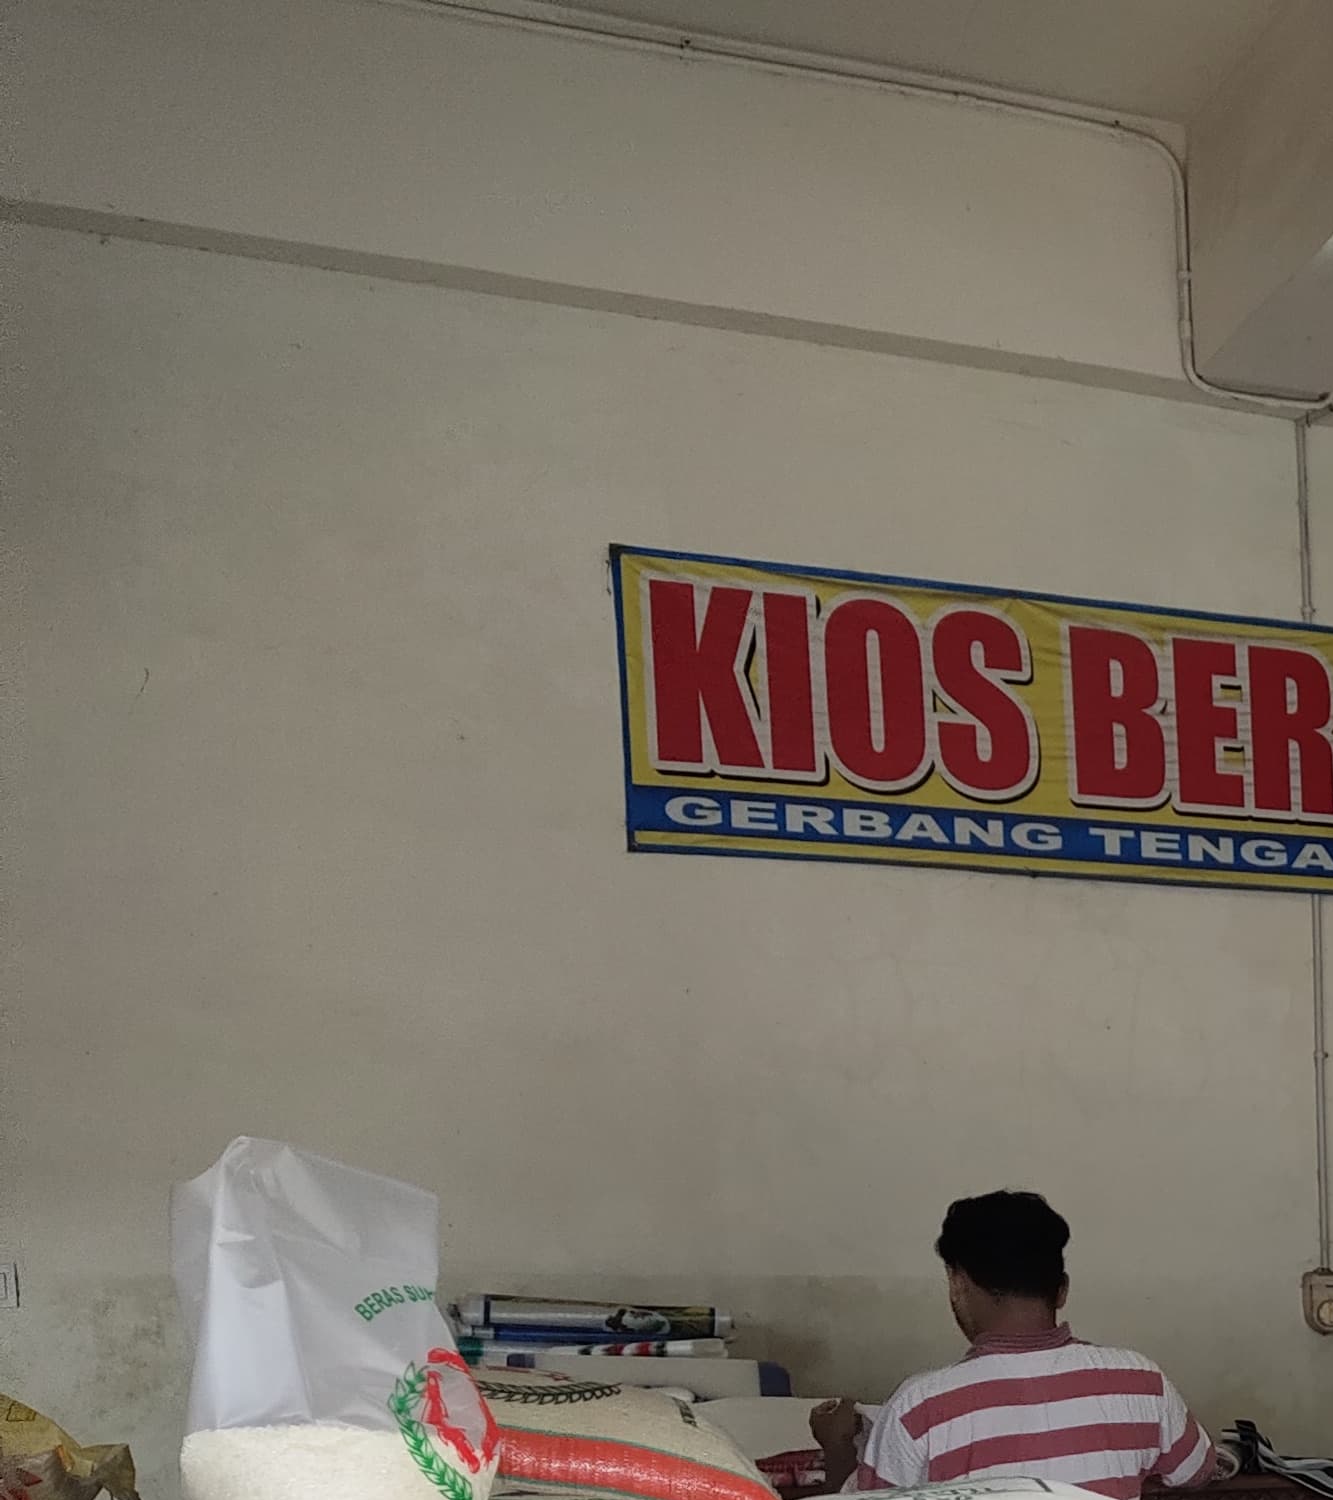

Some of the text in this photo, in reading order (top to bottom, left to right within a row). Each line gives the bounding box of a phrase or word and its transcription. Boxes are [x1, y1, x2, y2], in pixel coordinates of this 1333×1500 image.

[643, 574, 1038, 798] KIOS
[664, 794, 1064, 854] GERBANG
[354, 1286, 403, 1322] BERAS
